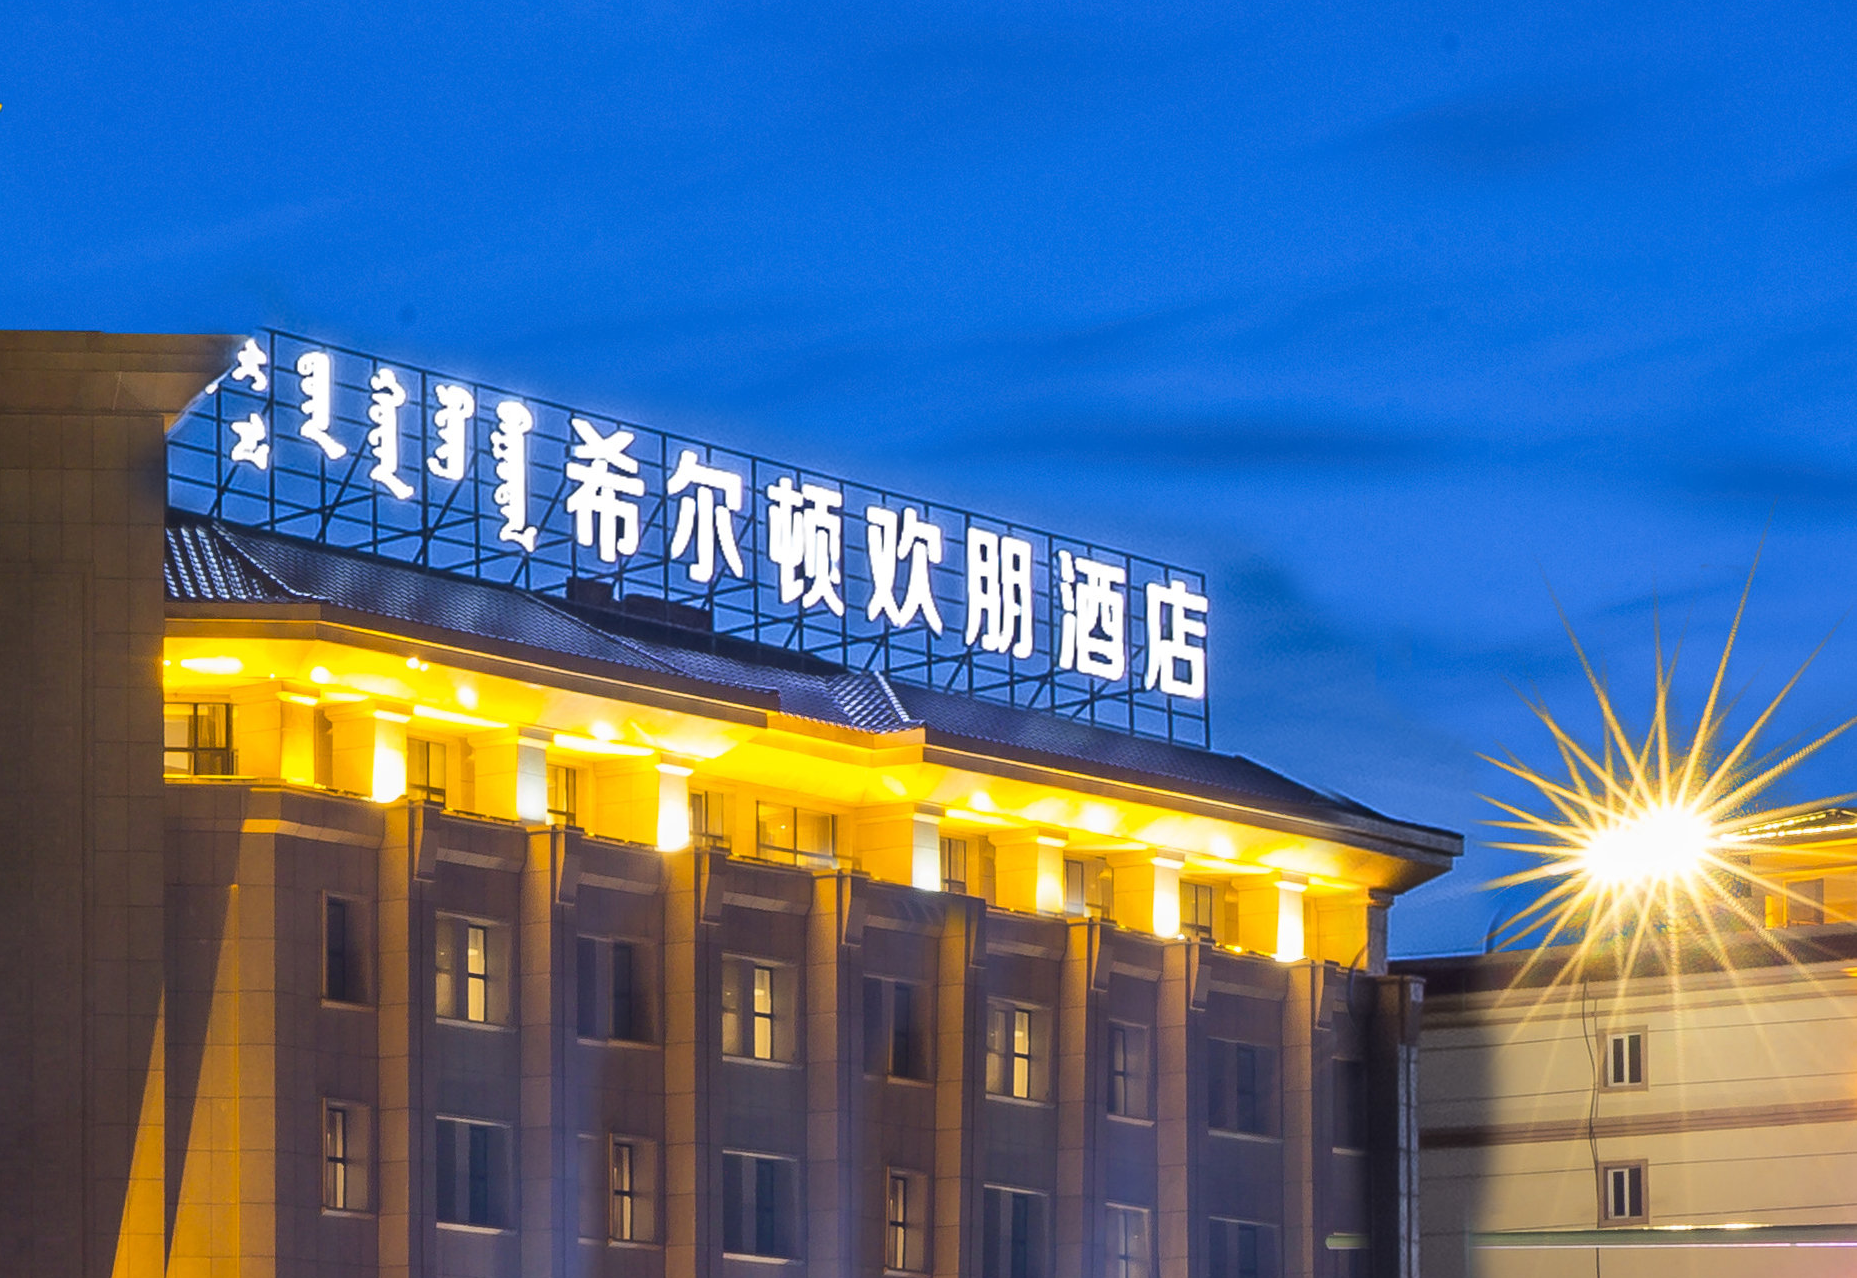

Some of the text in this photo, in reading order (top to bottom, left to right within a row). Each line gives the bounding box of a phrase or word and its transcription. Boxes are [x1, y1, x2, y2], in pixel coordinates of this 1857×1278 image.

[566, 418, 1209, 700] 希尔顿欢朋酒店
